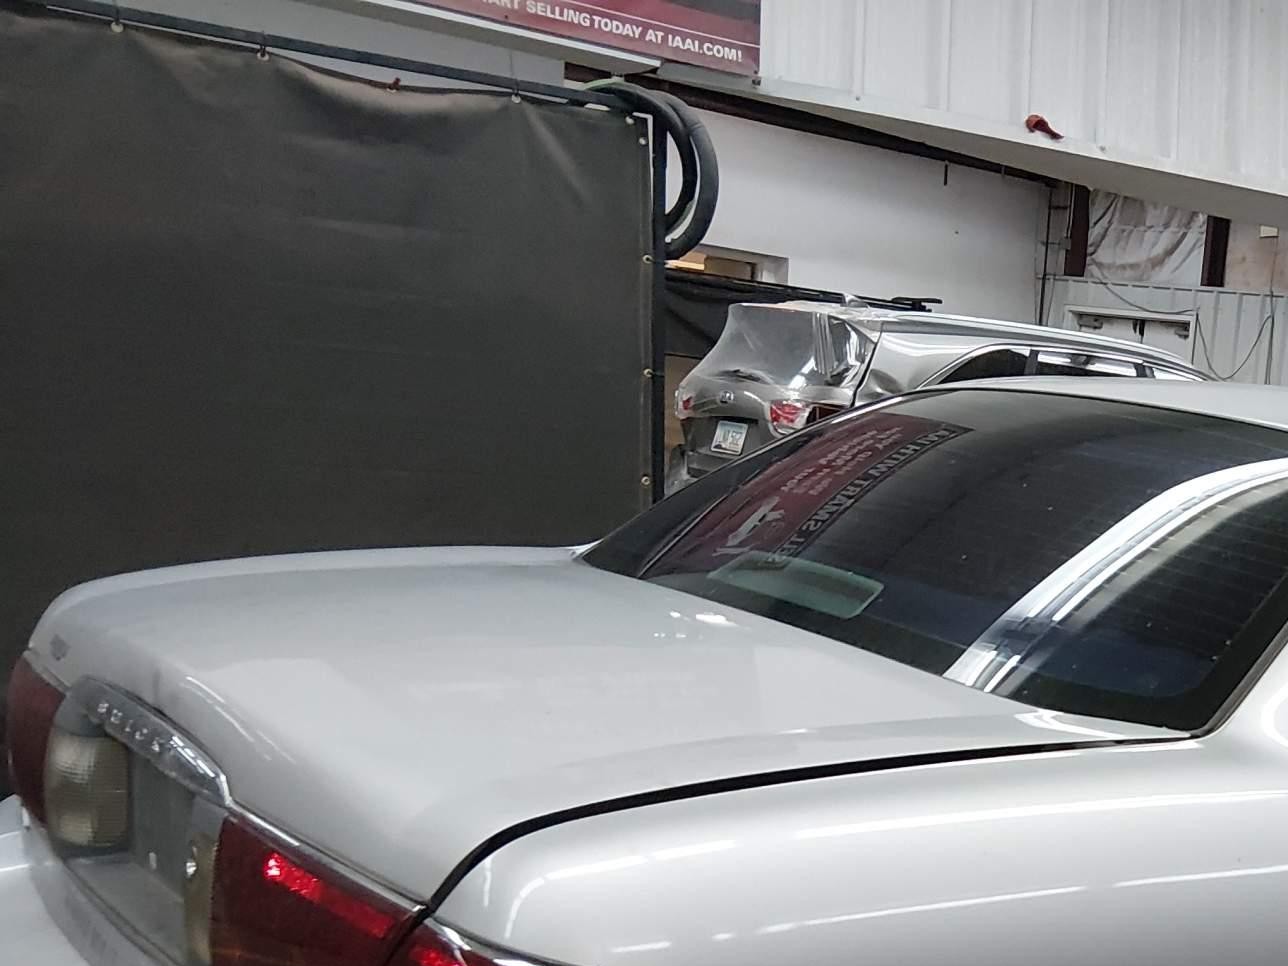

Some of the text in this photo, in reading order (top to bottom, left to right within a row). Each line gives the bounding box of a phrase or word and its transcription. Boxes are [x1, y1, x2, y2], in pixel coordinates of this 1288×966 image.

[526, 1, 742, 62] SELLING TODAY AT IAAI.COM!
